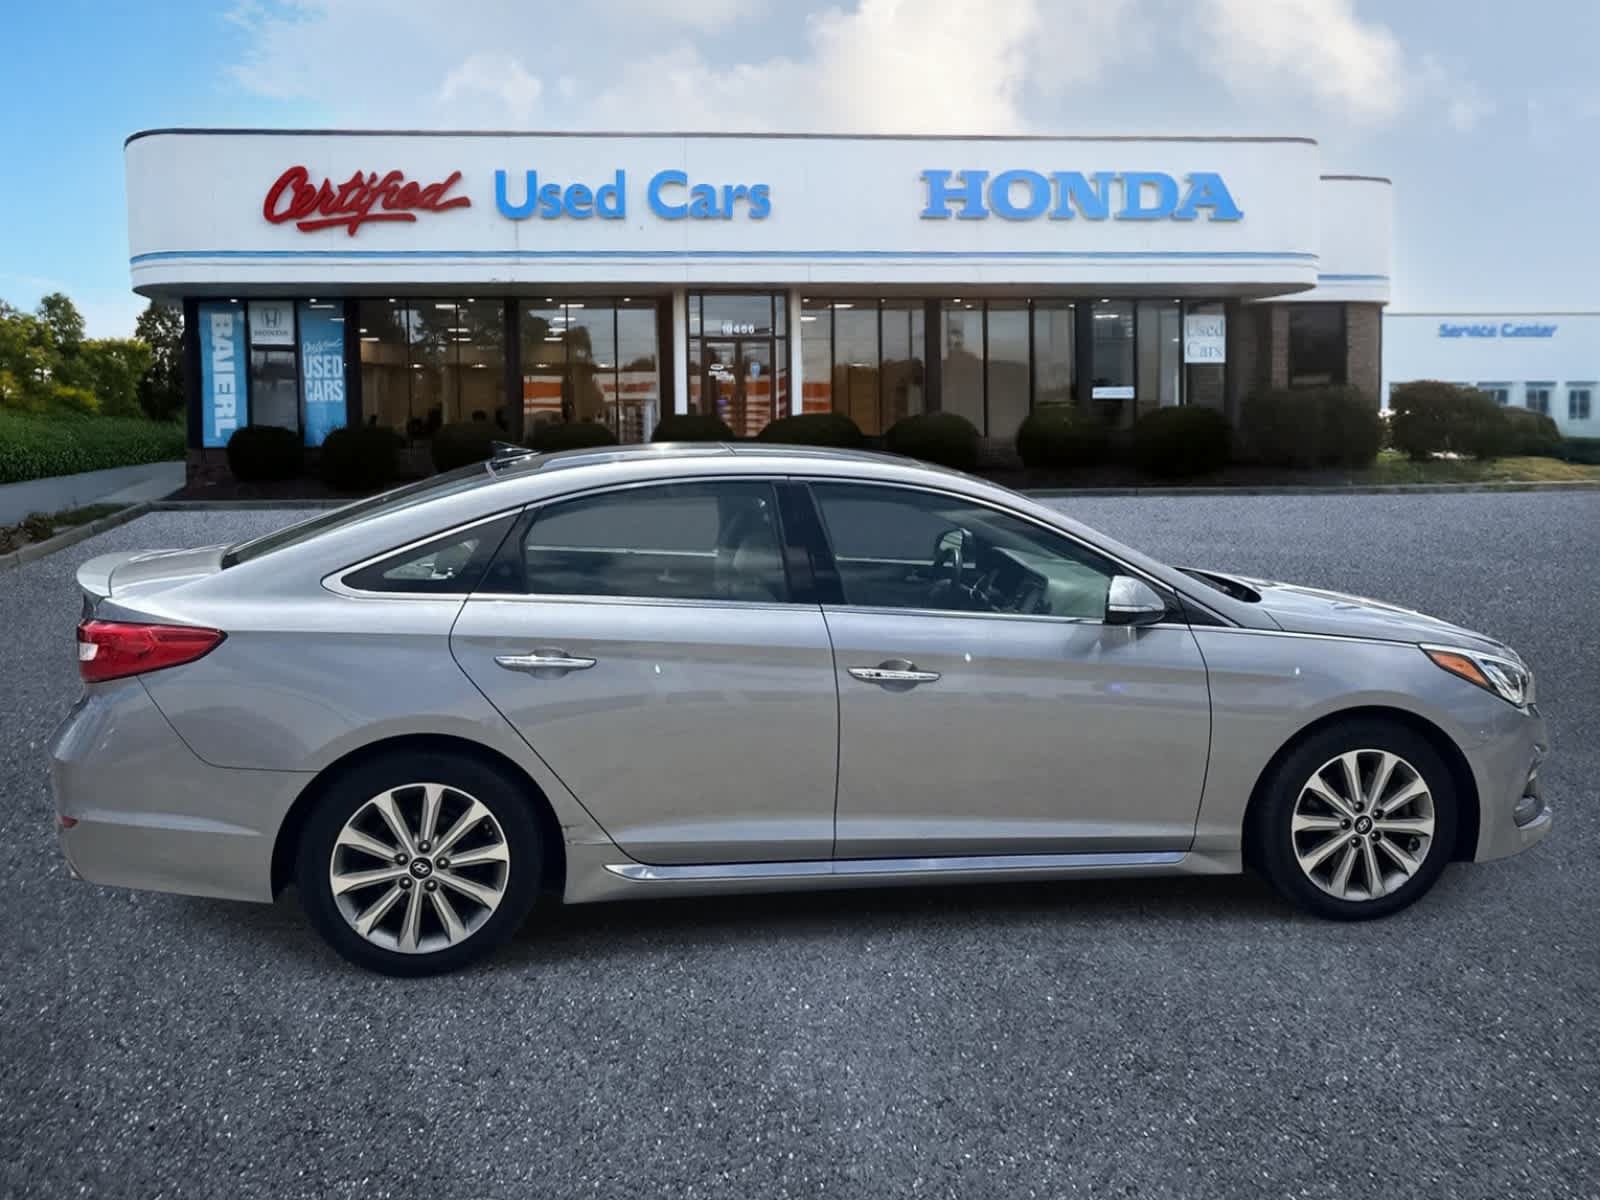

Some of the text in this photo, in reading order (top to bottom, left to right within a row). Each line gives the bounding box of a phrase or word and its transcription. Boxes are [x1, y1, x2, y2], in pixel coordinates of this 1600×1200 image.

[263, 166, 772, 237] Certified Used Cars
[920, 169, 1244, 221] HONDA
[1185, 319, 1224, 337] Used
[1187, 342, 1224, 357] Cars
[210, 312, 237, 438] BAIERL
[303, 355, 343, 378] USED
[305, 379, 344, 402] CARS
